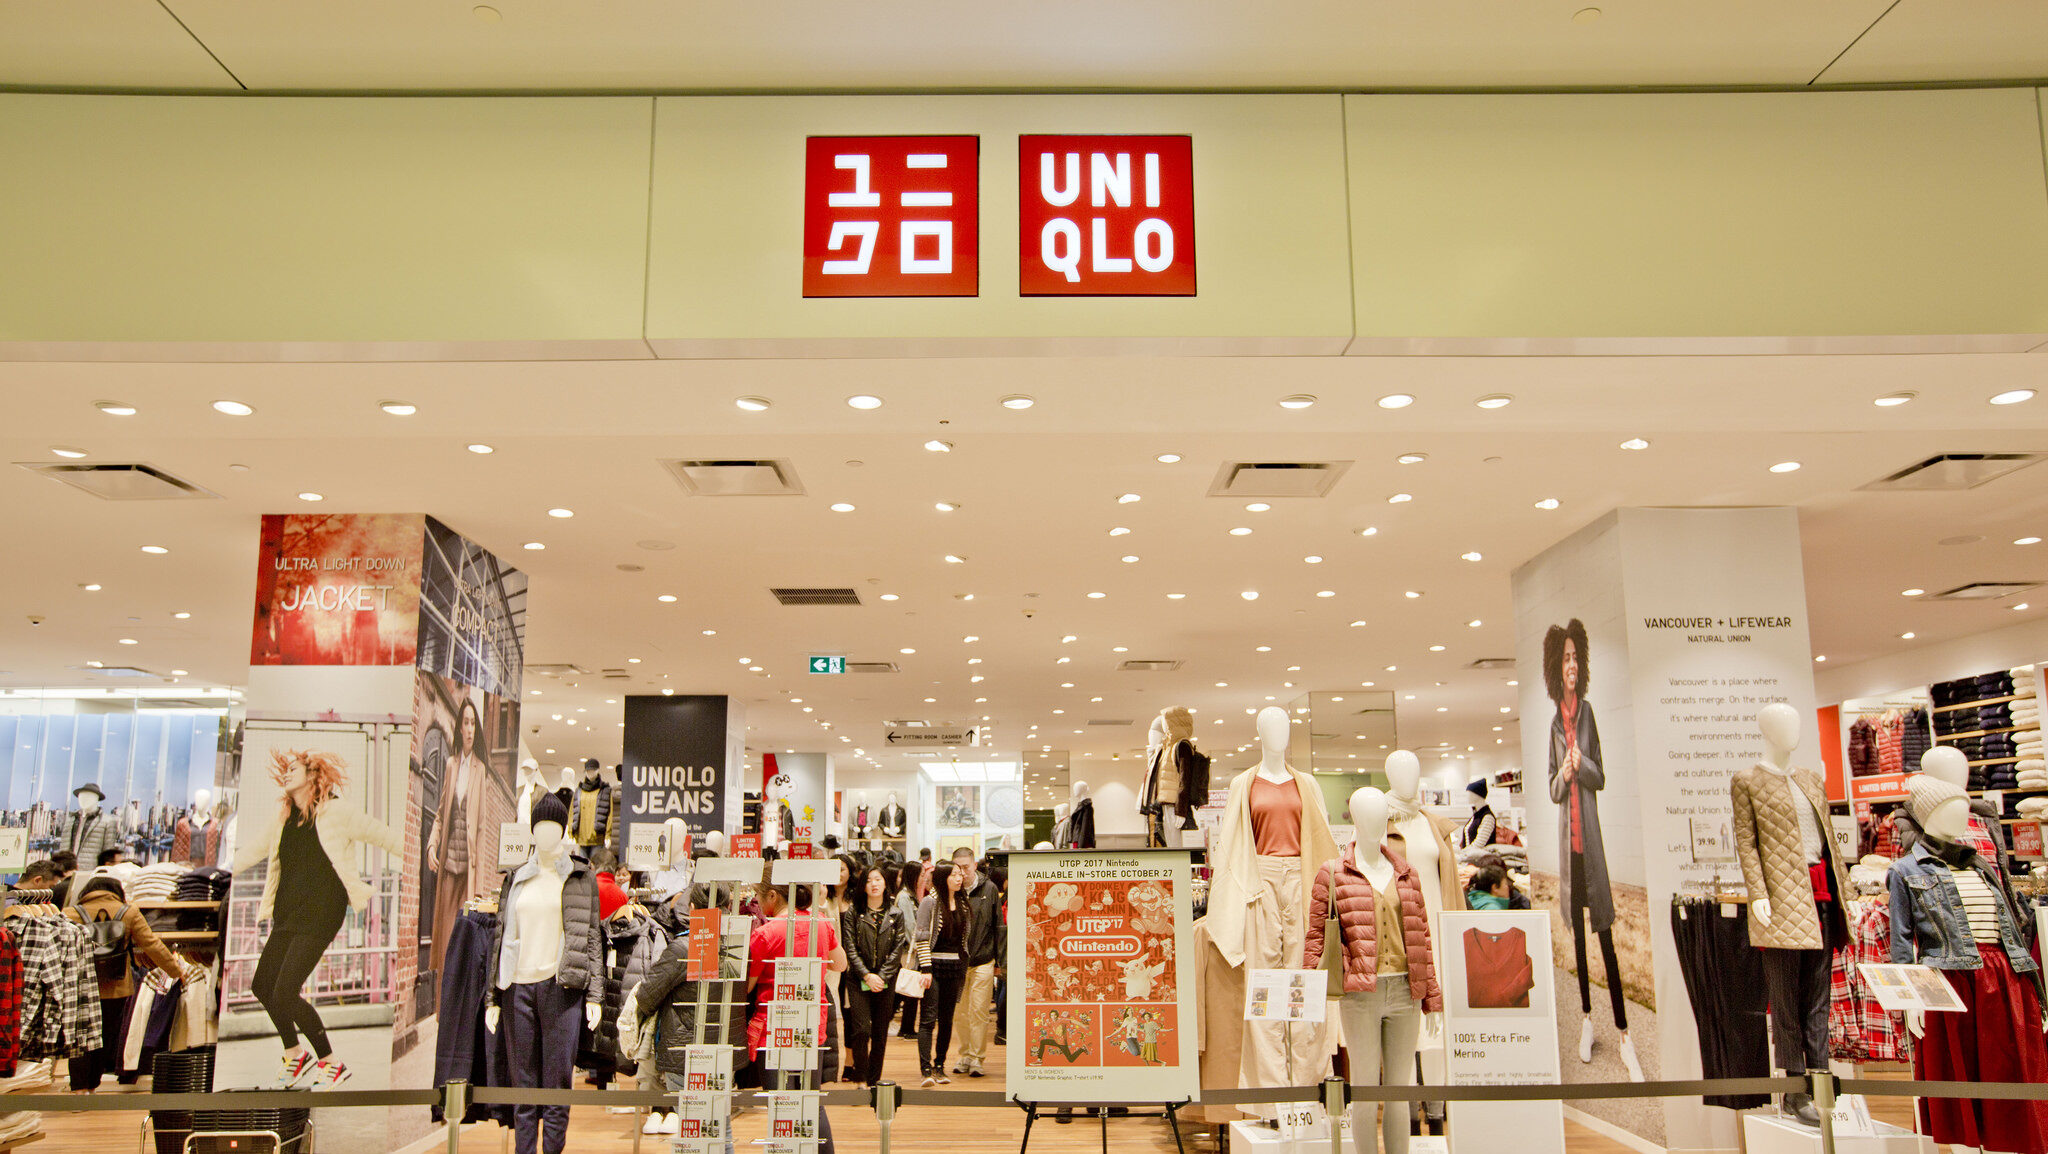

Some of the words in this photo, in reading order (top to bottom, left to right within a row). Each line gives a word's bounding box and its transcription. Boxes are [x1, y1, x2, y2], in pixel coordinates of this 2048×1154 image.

[828, 153, 953, 207] ユニ
[1040, 152, 1160, 208] UNI
[821, 220, 953, 275] クロ
[1040, 216, 1174, 283] QLO
[274, 558, 318, 571] ULTRA
[323, 558, 362, 571] LIGHT
[366, 558, 406, 571] DOWN
[280, 585, 394, 612] JACKET
[452, 604, 499, 646] COMPACT
[1644, 618, 1713, 629] VANCOUVER
[1728, 616, 1792, 628] LIFEWEAR
[1687, 635, 1725, 643] NATURAL
[1727, 634, 1751, 643] UNION
[1668, 677, 1710, 687] Vancouver
[1711, 677, 1718, 686] is
[1728, 677, 1751, 688] place
[1752, 677, 1778, 686] where
[1660, 696, 1696, 705] contrasts
[1728, 695, 1740, 704] On
[1742, 695, 1756, 704] the
[1683, 714, 1709, 722] where
[1711, 713, 1740, 722] natural
[1742, 712, 1757, 722] and
[1689, 732, 1742, 741] environments
[1744, 733, 1763, 741] mee
[1668, 750, 1691, 760] Going
[1737, 750, 1763, 758] where
[1674, 768, 1689, 778] and
[1691, 767, 1724, 777] cultures
[631, 766, 716, 791] UNIQLO
[1681, 787, 1694, 796] the
[1696, 787, 1720, 796] world
[631, 790, 716, 815] JEANS
[1665, 806, 1696, 815] Natural
[1698, 806, 1721, 815] Union
[1059, 860, 1081, 868] UTGP
[1106, 859, 1139, 867] Nintendo
[1679, 862, 1703, 871] which
[1026, 871, 1073, 879] AVAILABLE
[1076, 870, 1117, 878] IN-STORE
[1121, 870, 1159, 878] OCTOBER
[1163, 869, 1173, 877] 27
[1089, 882, 1125, 891] DONKEY
[1066, 940, 1134, 952] Nintendo
[1454, 1033, 1476, 1043] 100%
[1480, 1033, 1506, 1043] Extra
[1510, 1033, 1531, 1042] Fine
[1454, 1049, 1486, 1059] Merino
